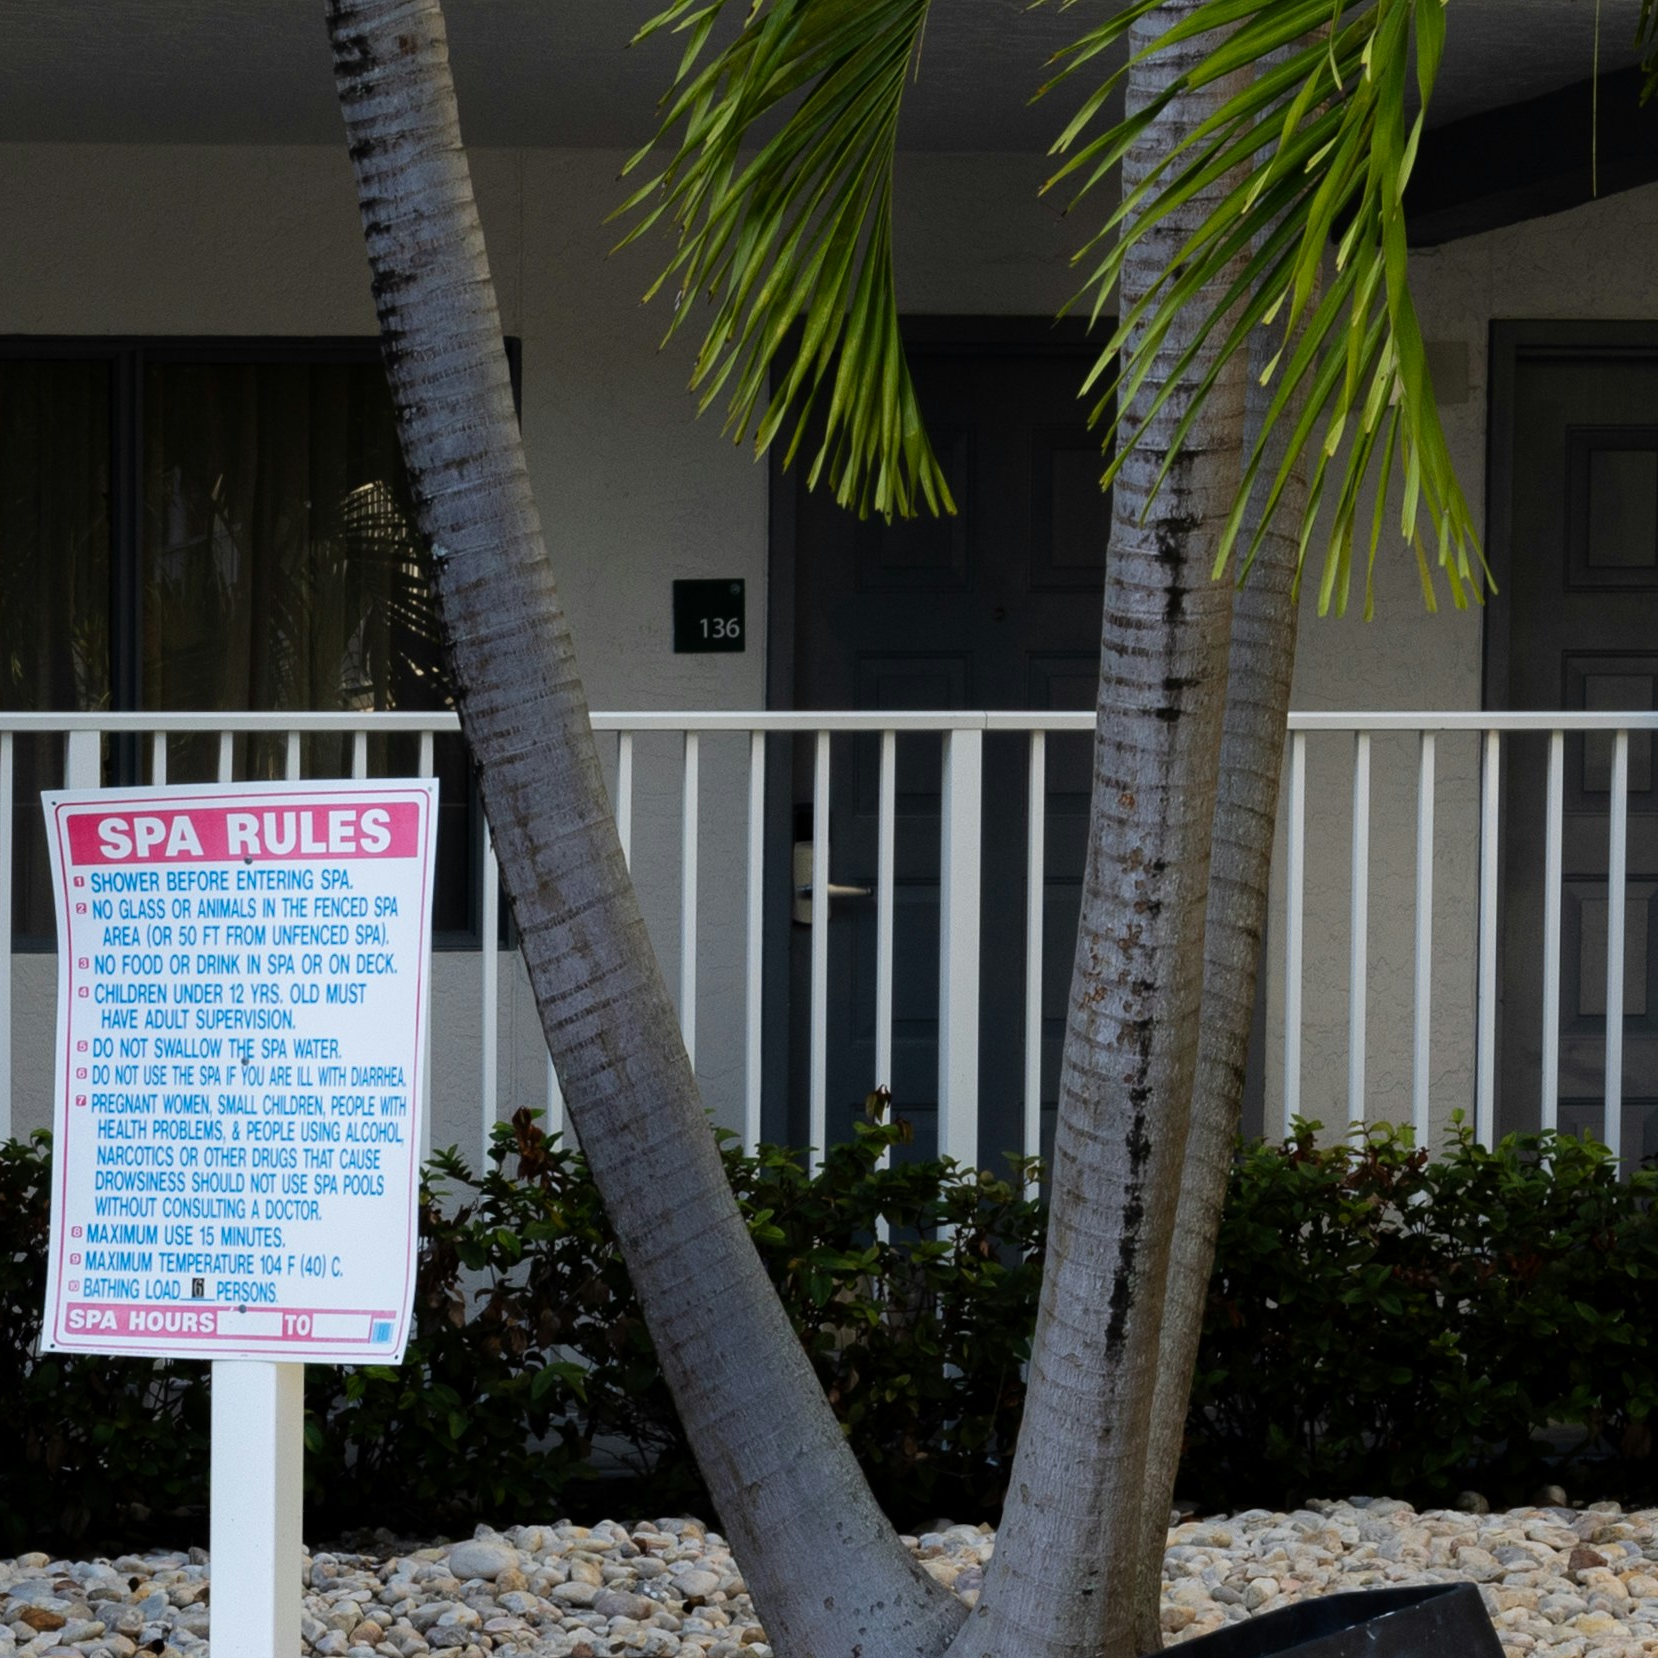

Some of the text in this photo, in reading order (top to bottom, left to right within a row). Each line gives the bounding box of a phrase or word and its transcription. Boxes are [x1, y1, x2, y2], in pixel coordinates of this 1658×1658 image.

[699, 617, 741, 639] 136
[98, 808, 392, 860] SPA RULES
[91, 871, 159, 892] SHOWER
[167, 870, 228, 891] BEFORE
[237, 870, 314, 891] ENTERING
[321, 870, 354, 890] SPA.
[93, 899, 111, 920] NO
[119, 898, 165, 919] GLASS
[172, 898, 191, 919] OR
[198, 898, 256, 918] ANIMALS
[262, 898, 276, 917] IN
[282, 897, 308, 917] THE
[314, 897, 368, 917] FENCED
[375, 896, 398, 917] SPA
[103, 922, 390, 949] AREA (OR 50 FT FROM UNFENCED SPA).
[95, 955, 116, 975] NO
[122, 955, 162, 975] FOOD
[169, 955, 190, 974] OR
[196, 954, 240, 974] DRINK
[247, 954, 260, 974] IN
[267, 954, 295, 974] SPA
[302, 954, 323, 974] OR
[329, 954, 350, 974] ON
[357, 953, 398, 974] DECK.
[95, 984, 167, 1004] CHILDREN
[173, 984, 223, 1004] UNDER
[229, 984, 244, 1004] 12
[251, 984, 283, 1004] YRS.
[290, 983, 319, 1003] OLD
[326, 983, 366, 1003] MUST
[102, 1009, 296, 1030] HAVE ADULT SUPERVISION.
[93, 1038, 114, 1058] DO
[120, 1038, 148, 1058] NOT
[155, 1038, 222, 1058] SWALLOW
[229, 1038, 256, 1058] THE
[262, 1038, 287, 1058] SPA
[294, 1038, 342, 1059] WATER.
[92, 1065, 109, 1085] DO
[115, 1065, 138, 1085] NOT
[144, 1065, 168, 1085] USE
[174, 1065, 193, 1085] THE
[199, 1065, 221, 1086] SPA
[226, 1065, 236, 1086] IF
[241, 1065, 263, 1087] YOU
[269, 1065, 291, 1086] ARE
[297, 1066, 312, 1087] ILL
[318, 1066, 346, 1087] WITH
[352, 1066, 406, 1088] DIARRHEA.
[91, 1094, 157, 1115] PREGNANT
[163, 1094, 212, 1117] WOMEN,
[218, 1094, 257, 1116] SMALL
[263, 1094, 326, 1118] CHILDREN,
[331, 1095, 374, 1116] PEOPLE
[380, 1095, 406, 1117] WITH
[98, 1119, 404, 1145] HEALTH PROBLEMS, & PEOPLE USING ALCOHOL,
[97, 1146, 380, 1169] NARCOTICS OR OTHER DRUGS THAT CAUSE
[95, 1171, 384, 1196] DROWSINESS SHOULD NOT USE SPA POOLS
[95, 1197, 322, 1220] WITHOUT CONSULTING A DOCTOR.
[87, 1224, 158, 1245] MAXIMUM
[164, 1225, 193, 1245] USE
[200, 1226, 214, 1246] 15
[221, 1227, 285, 1249] MINUTES.
[85, 1252, 153, 1272] MAXIMUM
[159, 1253, 254, 1274] TEMPERATURE
[260, 1254, 282, 1275] 104
[288, 1255, 295, 1276] F
[300, 1255, 326, 1279] (40)
[332, 1255, 343, 1277] C.
[84, 1278, 139, 1299] BATHING
[146, 1279, 180, 1300] LOAD
[192, 1278, 205, 1298] 6
[69, 1309, 311, 1336] SPA HOURS TO
